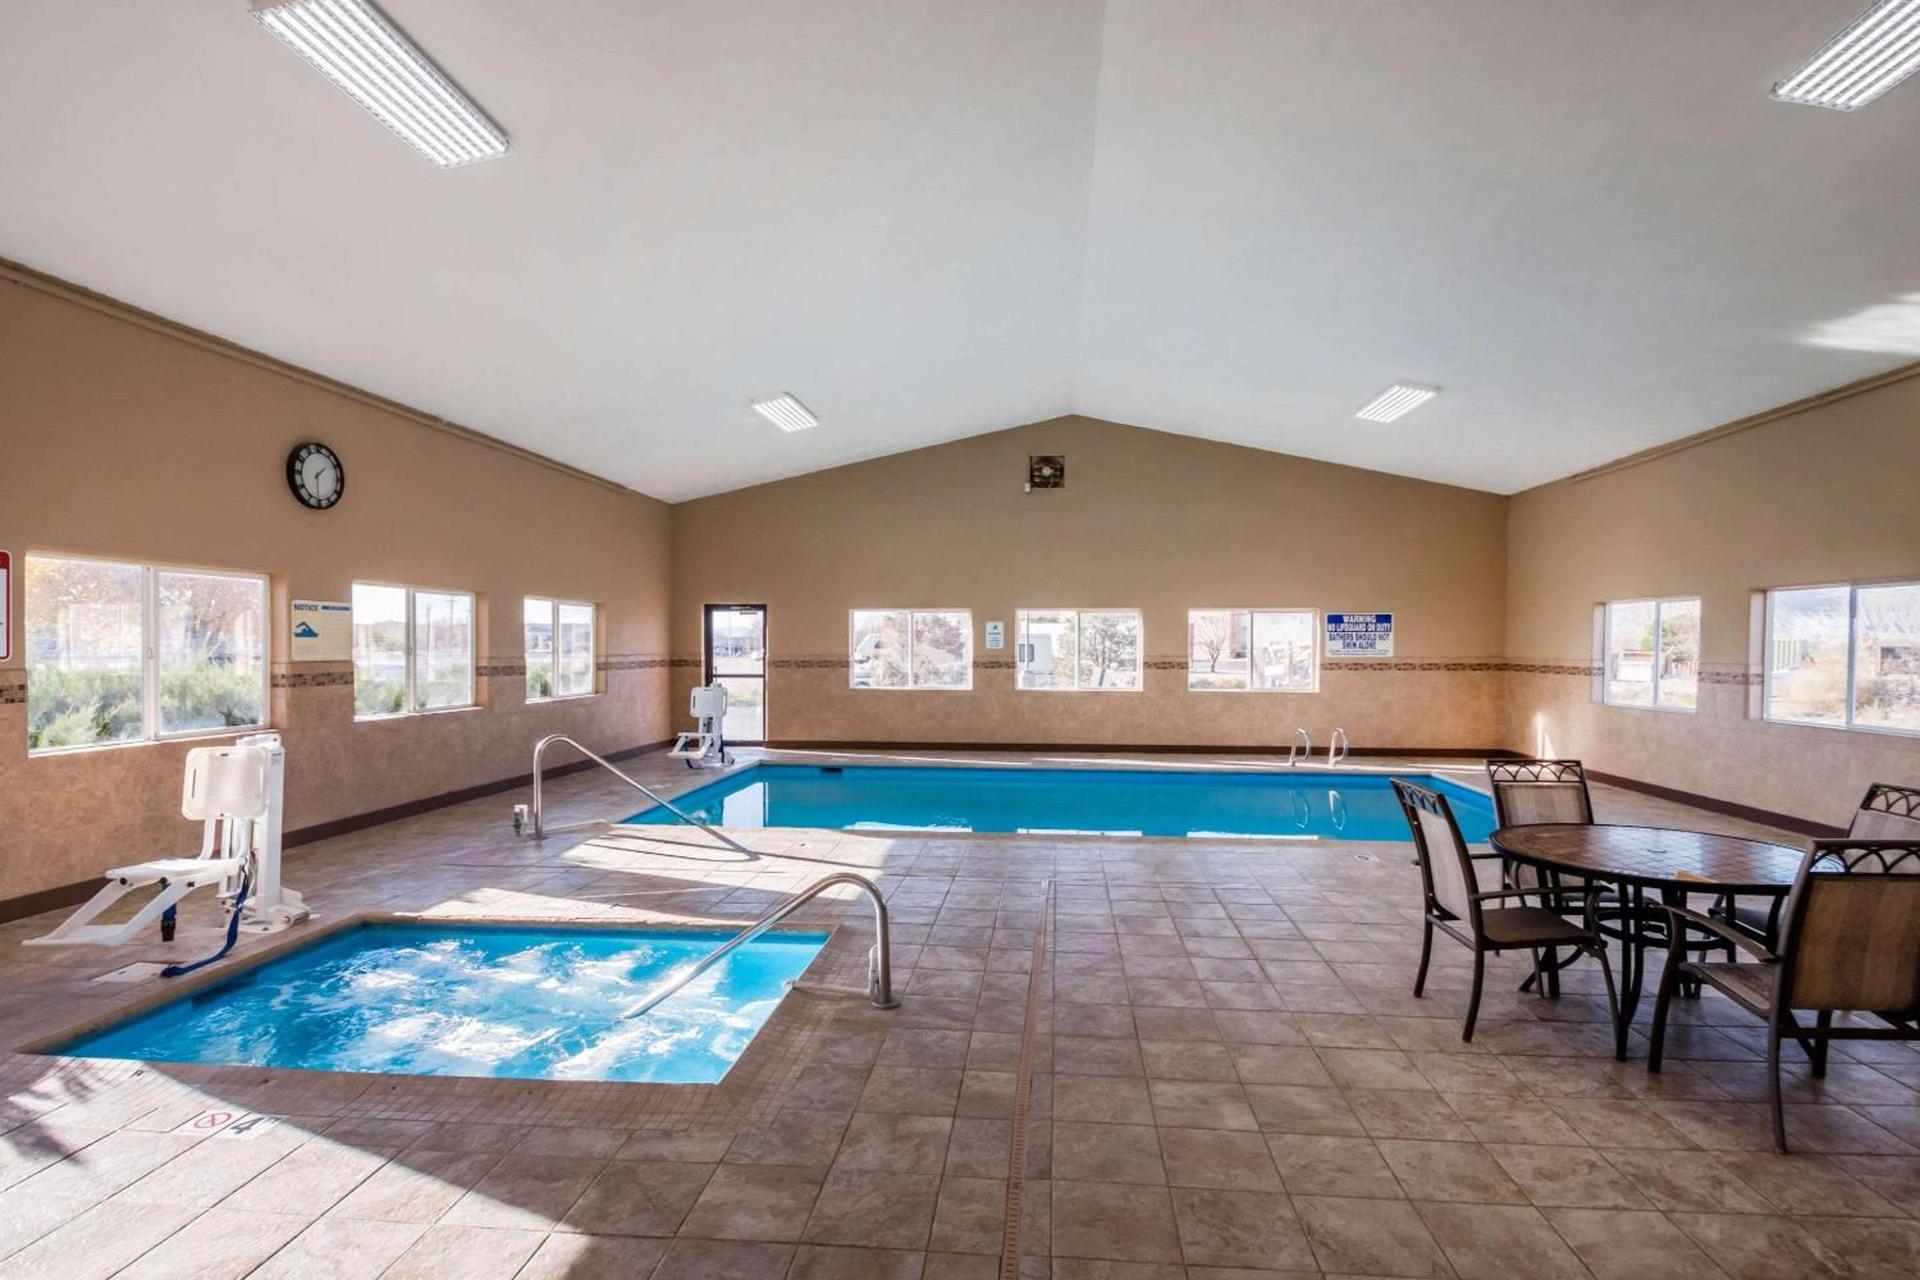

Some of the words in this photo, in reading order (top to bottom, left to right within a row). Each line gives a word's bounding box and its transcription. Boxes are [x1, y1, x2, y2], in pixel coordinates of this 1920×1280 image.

[293, 603, 319, 612] NOTICE
[1343, 615, 1377, 623] WARNING
[1336, 623, 1367, 632] LIFEGUARD
[1367, 623, 1376, 632] ON
[1376, 623, 1391, 632] DUTY
[1328, 633, 1354, 641] BATHERS
[1355, 633, 1377, 641] SHOULD
[1378, 633, 1390, 641] NOT
[1342, 641, 1358, 649] SWIM
[1358, 641, 1377, 649] ALONE
